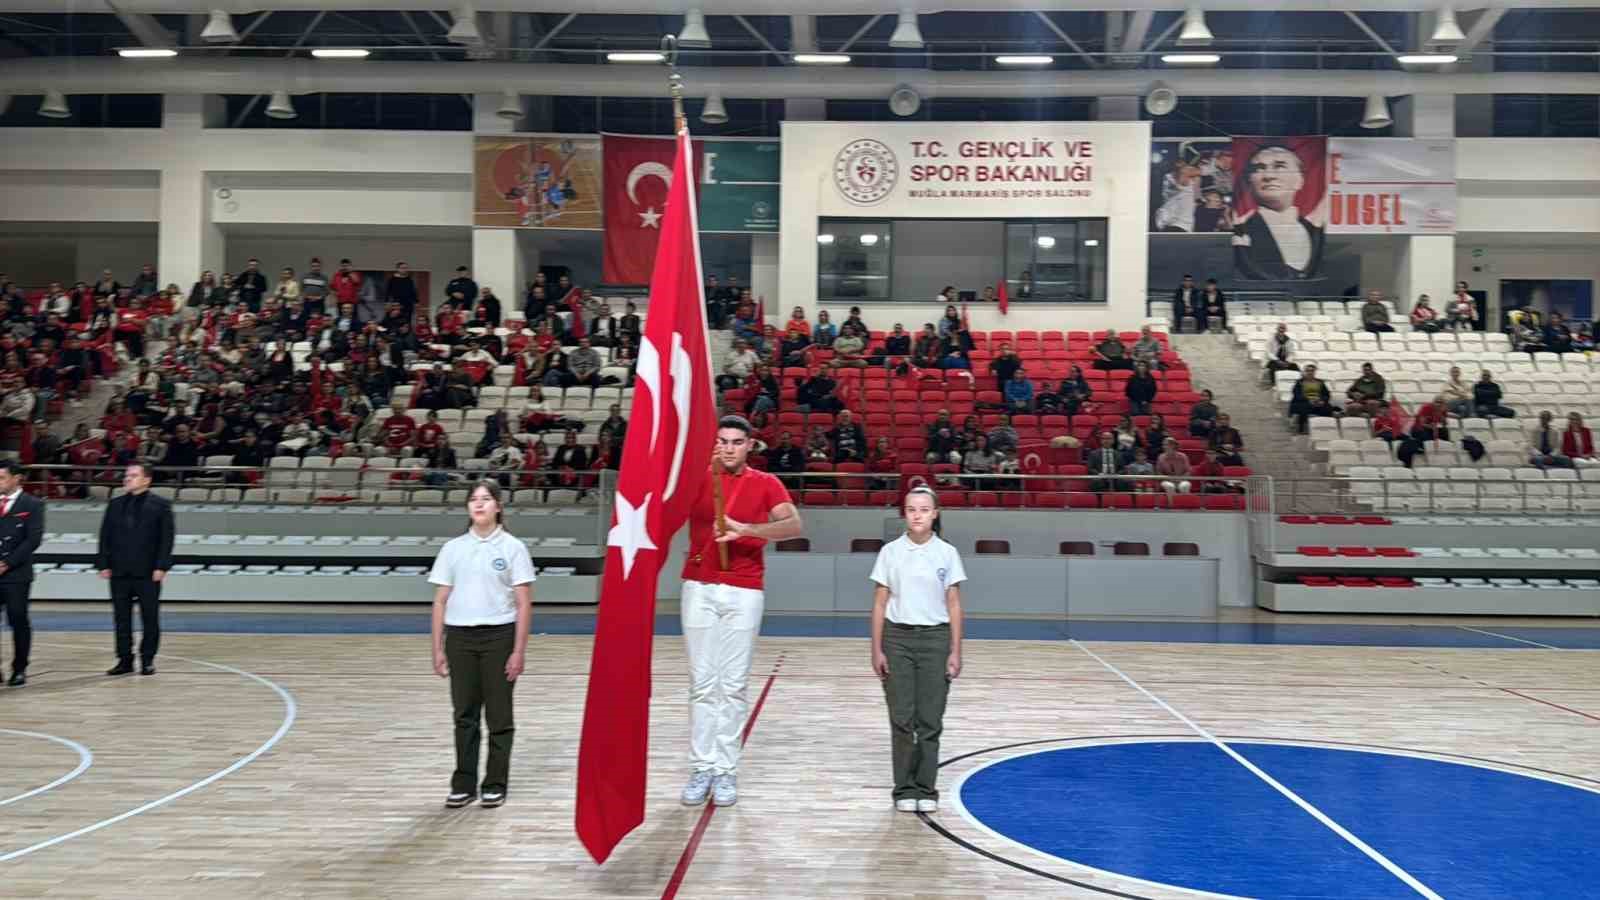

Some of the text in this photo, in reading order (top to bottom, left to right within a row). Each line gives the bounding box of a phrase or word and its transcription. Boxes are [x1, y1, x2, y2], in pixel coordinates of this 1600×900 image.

[909, 138, 1093, 162] T.C. GENÇLİK VE
[910, 162, 1092, 182] SPOR BAKANLIĞI
[1012, 189, 1042, 198] SPOR
[1045, 189, 1092, 198] SALONU
